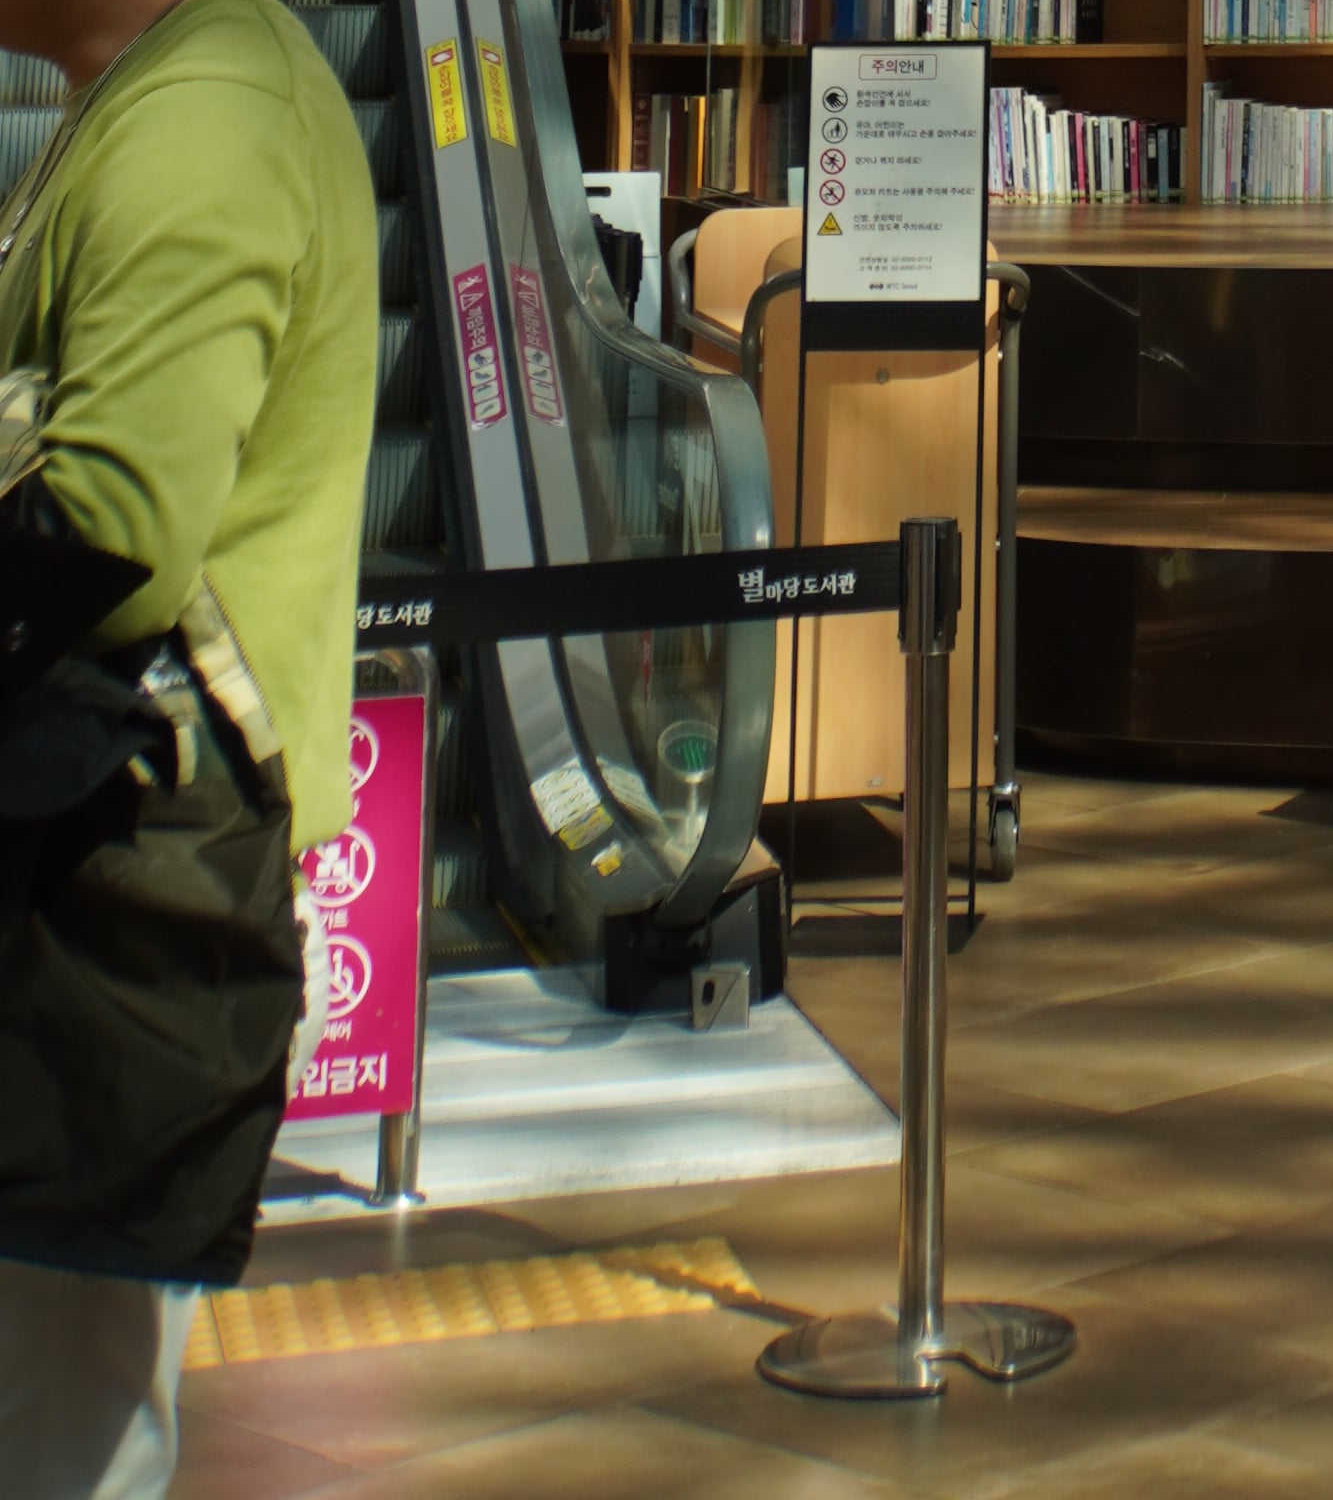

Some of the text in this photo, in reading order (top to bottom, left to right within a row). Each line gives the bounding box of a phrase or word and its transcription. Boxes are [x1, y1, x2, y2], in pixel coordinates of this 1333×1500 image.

[872, 59, 925, 74] 주의안내
[466, 305, 488, 351] 끼임주의
[290, 1052, 388, 1099] 입금지
